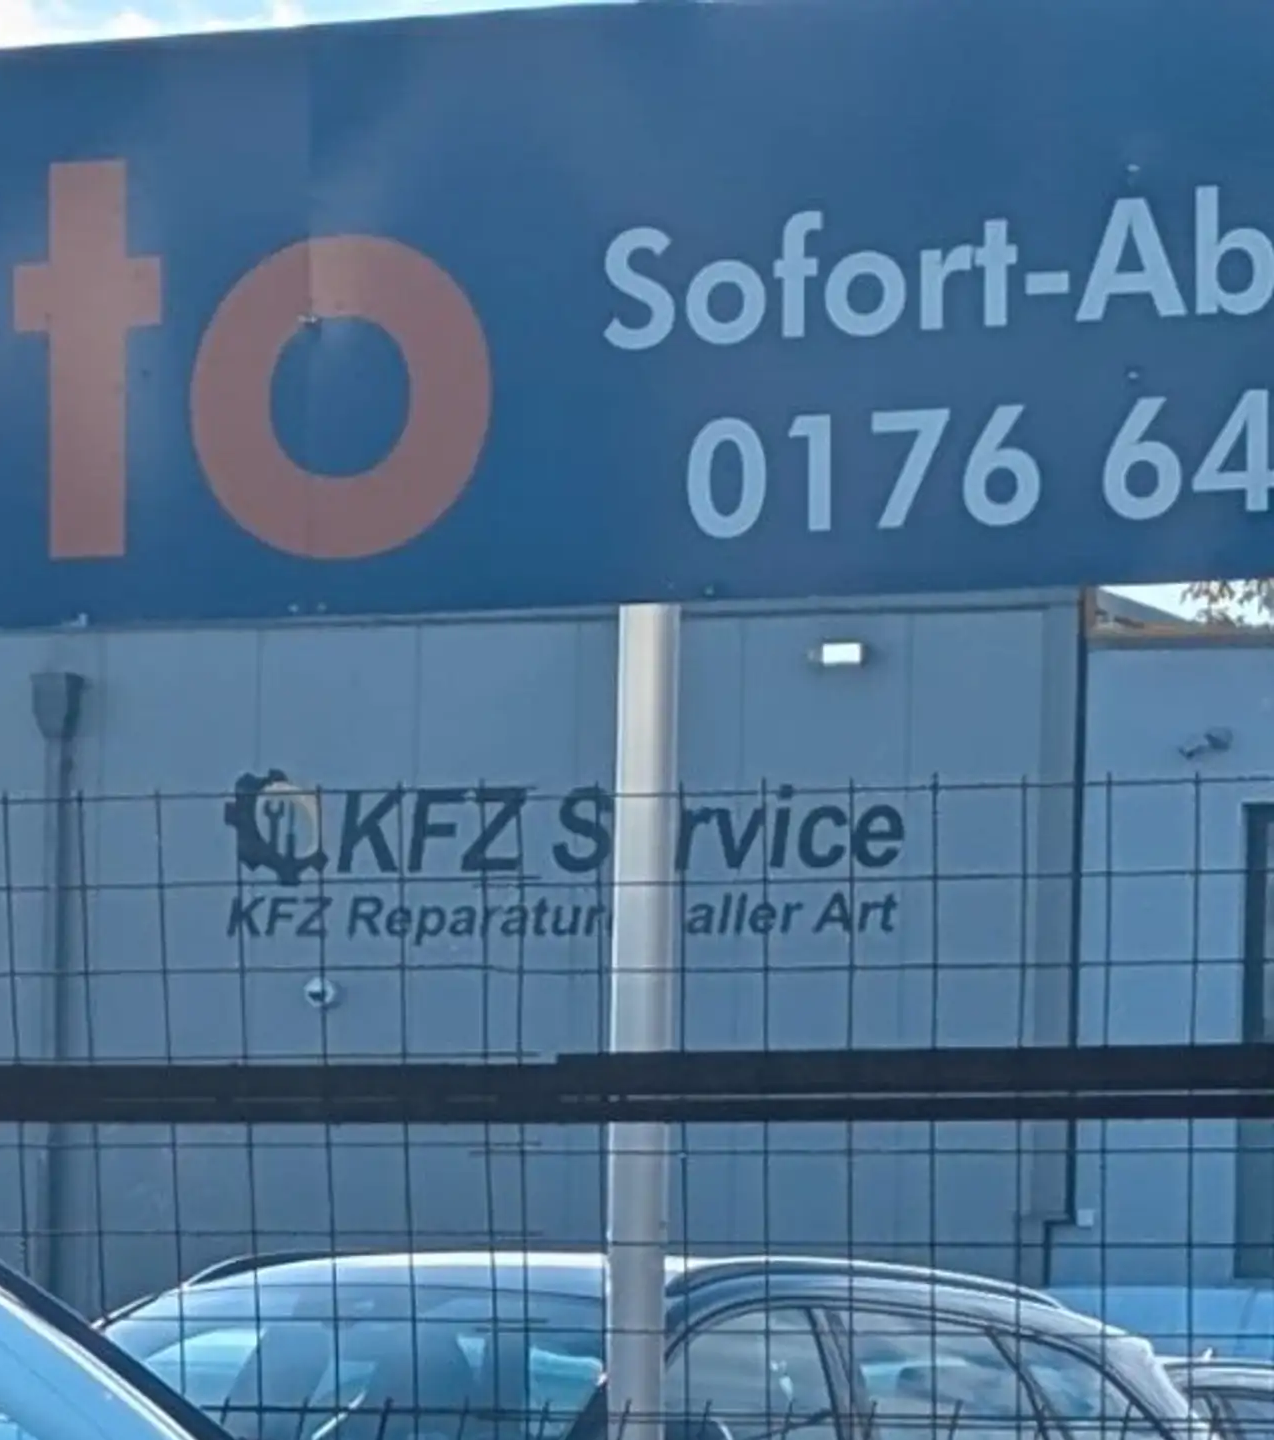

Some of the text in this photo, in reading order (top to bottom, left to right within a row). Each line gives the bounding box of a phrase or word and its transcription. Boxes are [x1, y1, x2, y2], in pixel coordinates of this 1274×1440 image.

[603, 185, 1274, 350] Sofort-Ab
[687, 389, 1274, 539] 0176 64
[337, 784, 905, 873] KFZ Srvice
[227, 891, 897, 946] KFZ Reparatur aller Art
